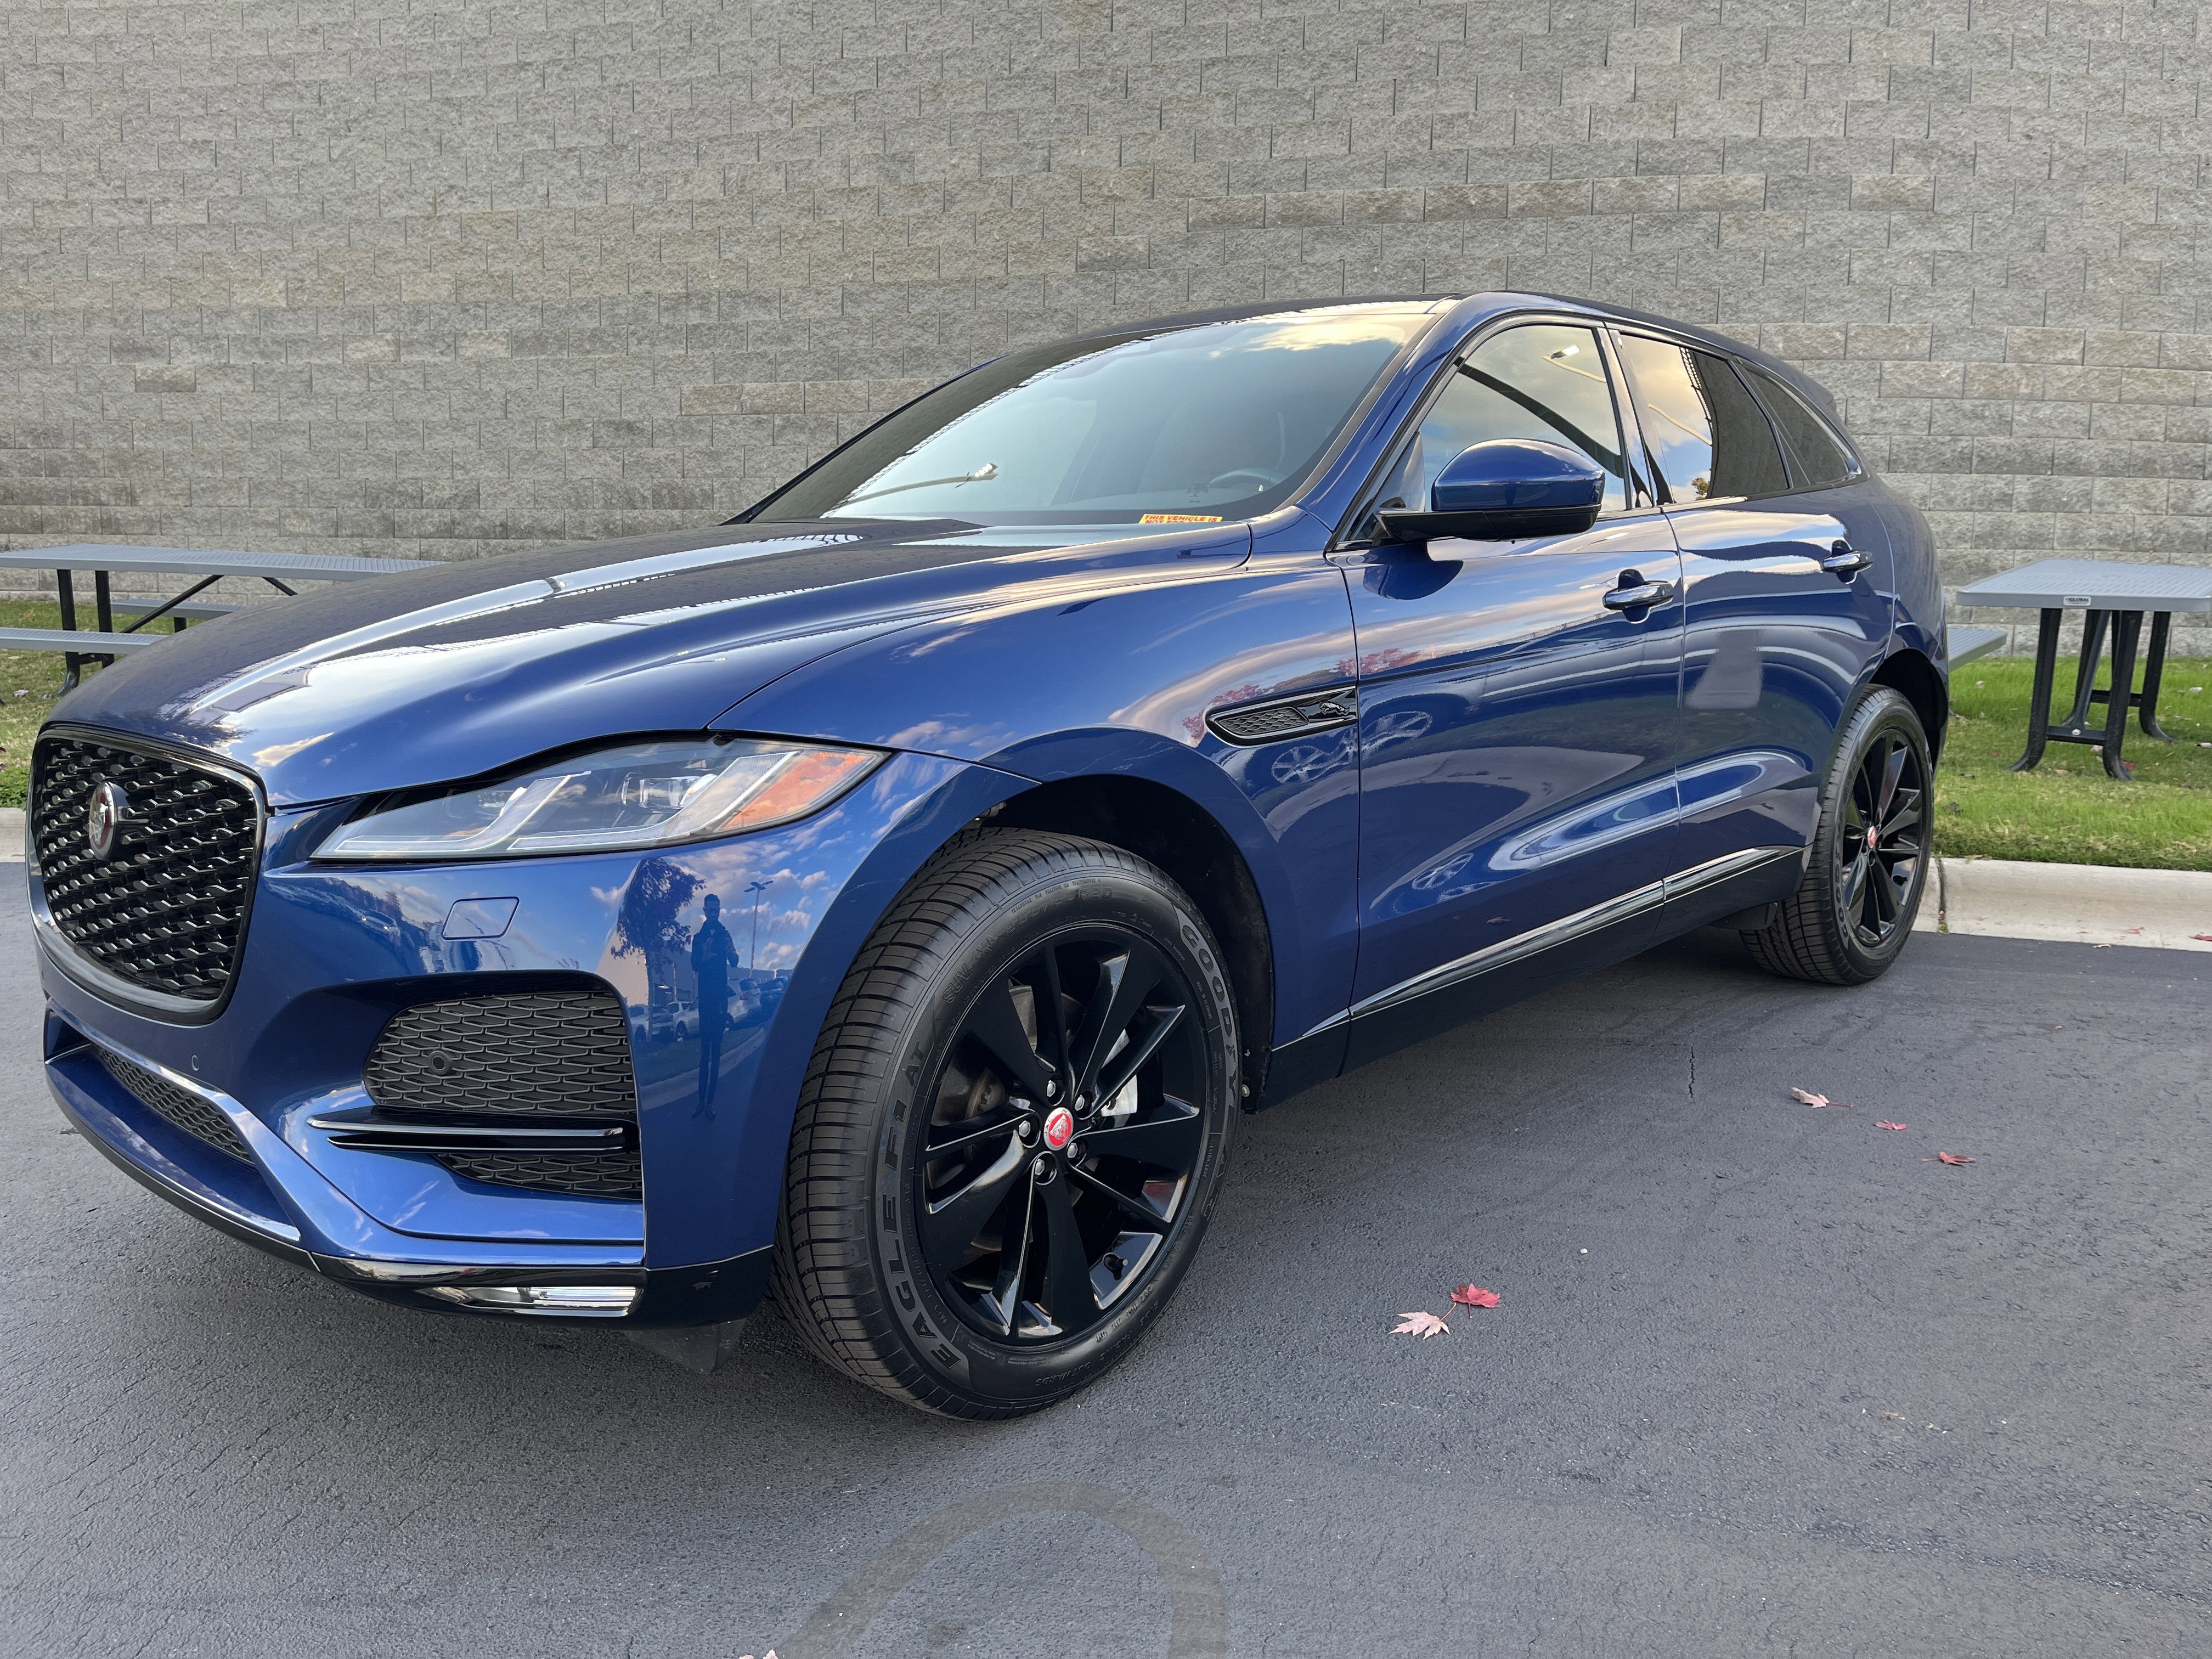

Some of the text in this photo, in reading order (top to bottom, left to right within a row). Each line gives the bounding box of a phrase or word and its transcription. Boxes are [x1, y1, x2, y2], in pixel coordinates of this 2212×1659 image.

[904, 1041, 924, 1086] AT
[1182, 925, 1238, 1221] GOODYEAR
[882, 1194, 962, 1369] EAGLE
